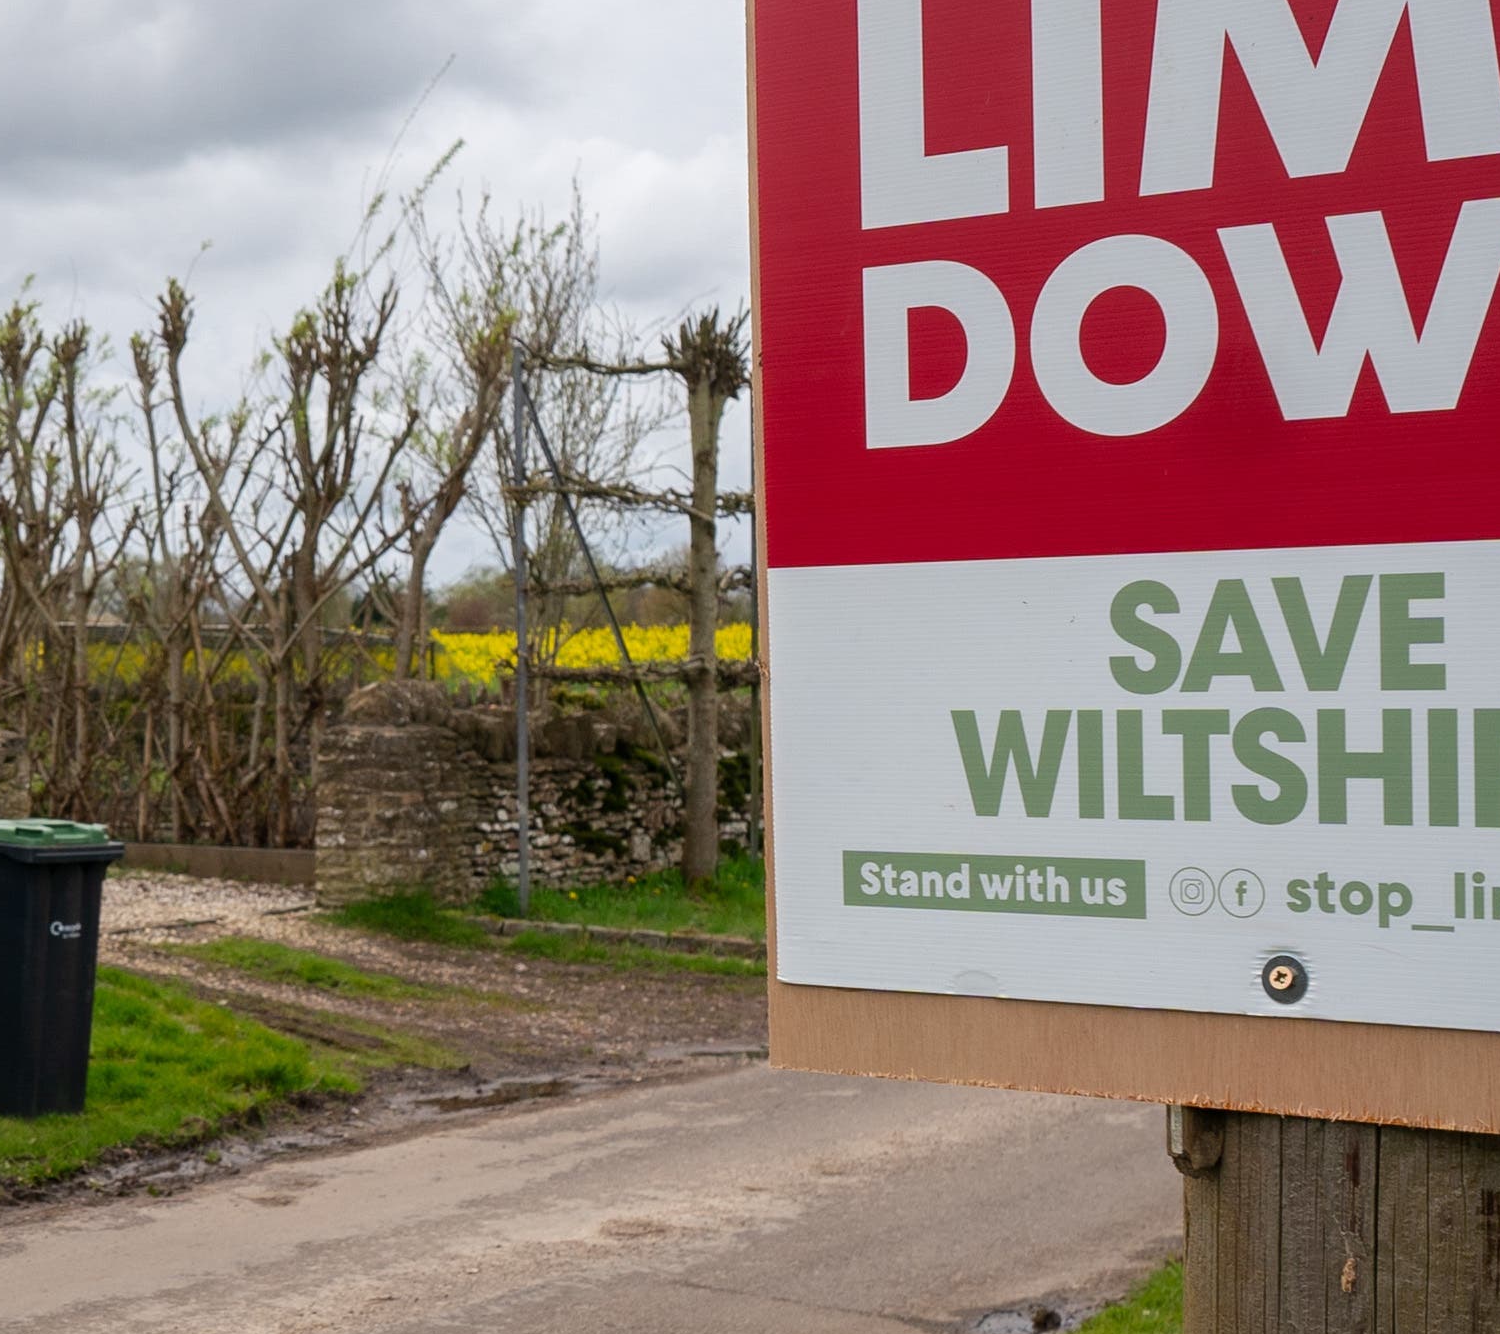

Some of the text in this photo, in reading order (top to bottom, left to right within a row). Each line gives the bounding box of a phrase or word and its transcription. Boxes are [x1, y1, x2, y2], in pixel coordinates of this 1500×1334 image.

[1108, 572, 1446, 694] SAVE
[861, 863, 1126, 905] Stand with us
